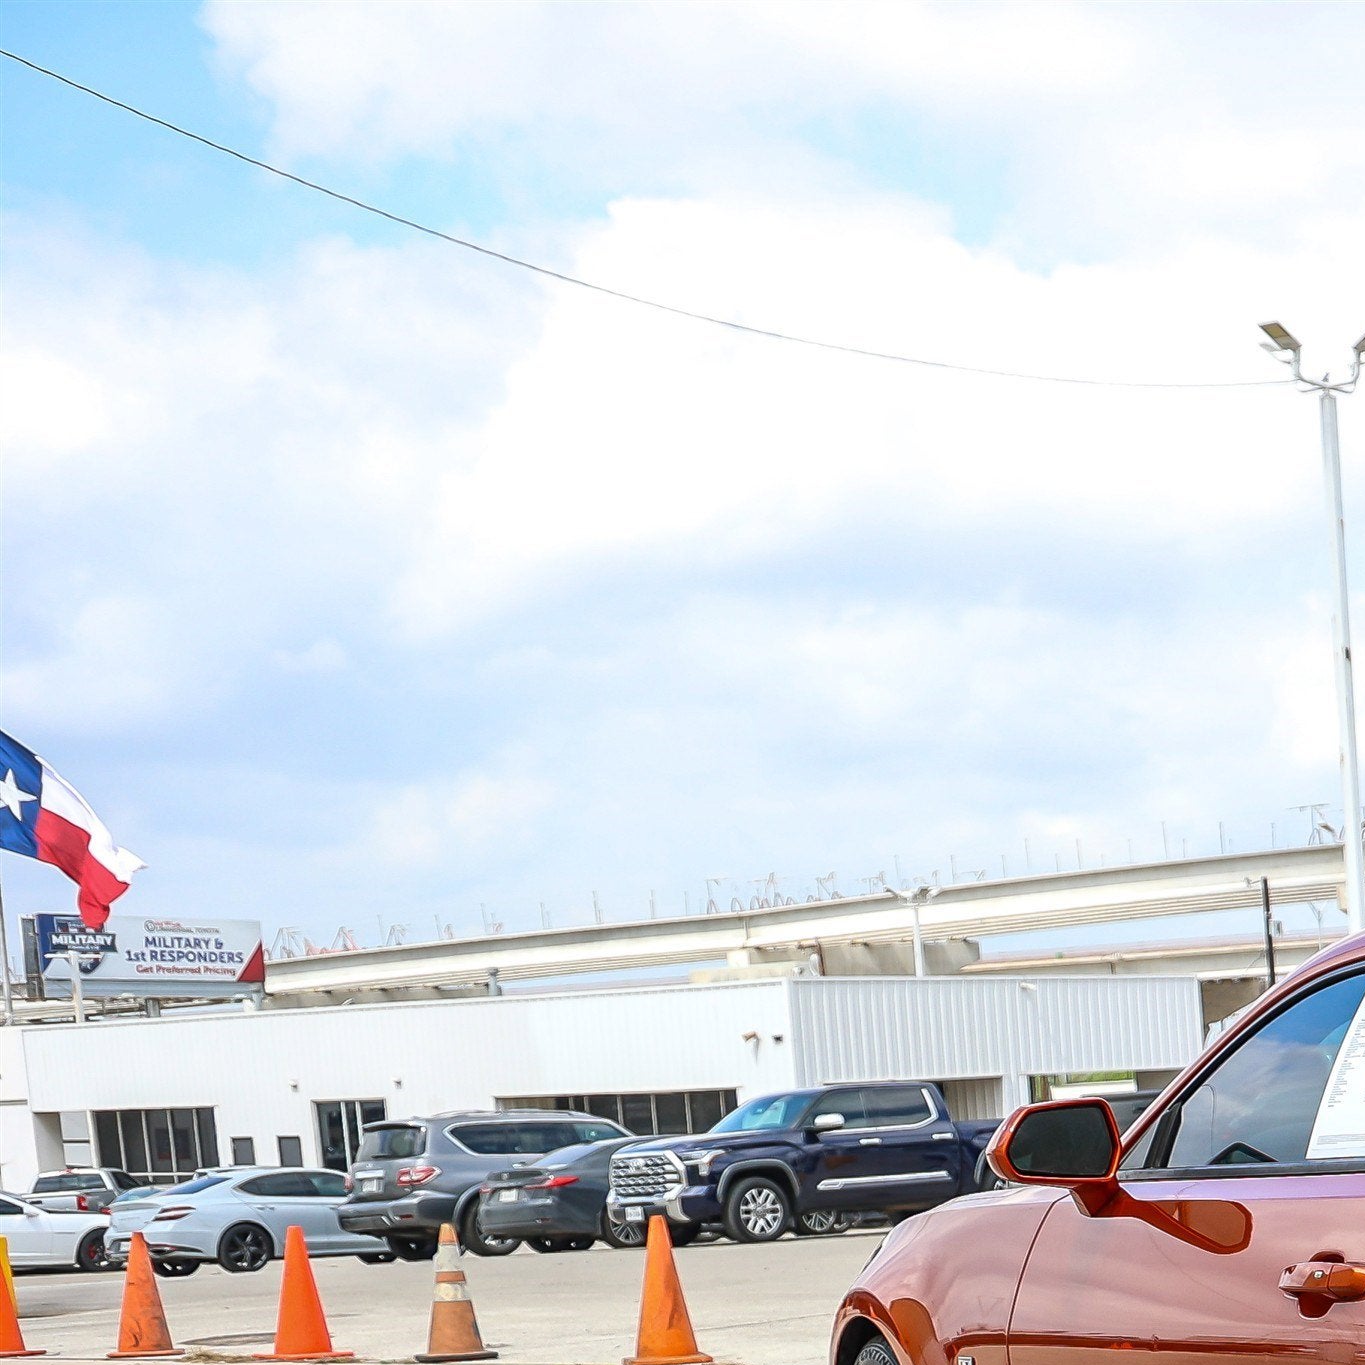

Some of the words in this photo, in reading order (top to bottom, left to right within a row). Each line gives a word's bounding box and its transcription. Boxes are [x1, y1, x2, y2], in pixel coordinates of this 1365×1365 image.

[51, 934, 113, 946] MILITARY
[144, 936, 211, 949] MILITARY
[214, 938, 224, 949] &
[125, 950, 146, 962] 1st
[149, 950, 244, 963] RESPONDERS
[136, 965, 154, 974] Get
[156, 965, 201, 975] Preferred
[203, 966, 236, 976] Pricing
